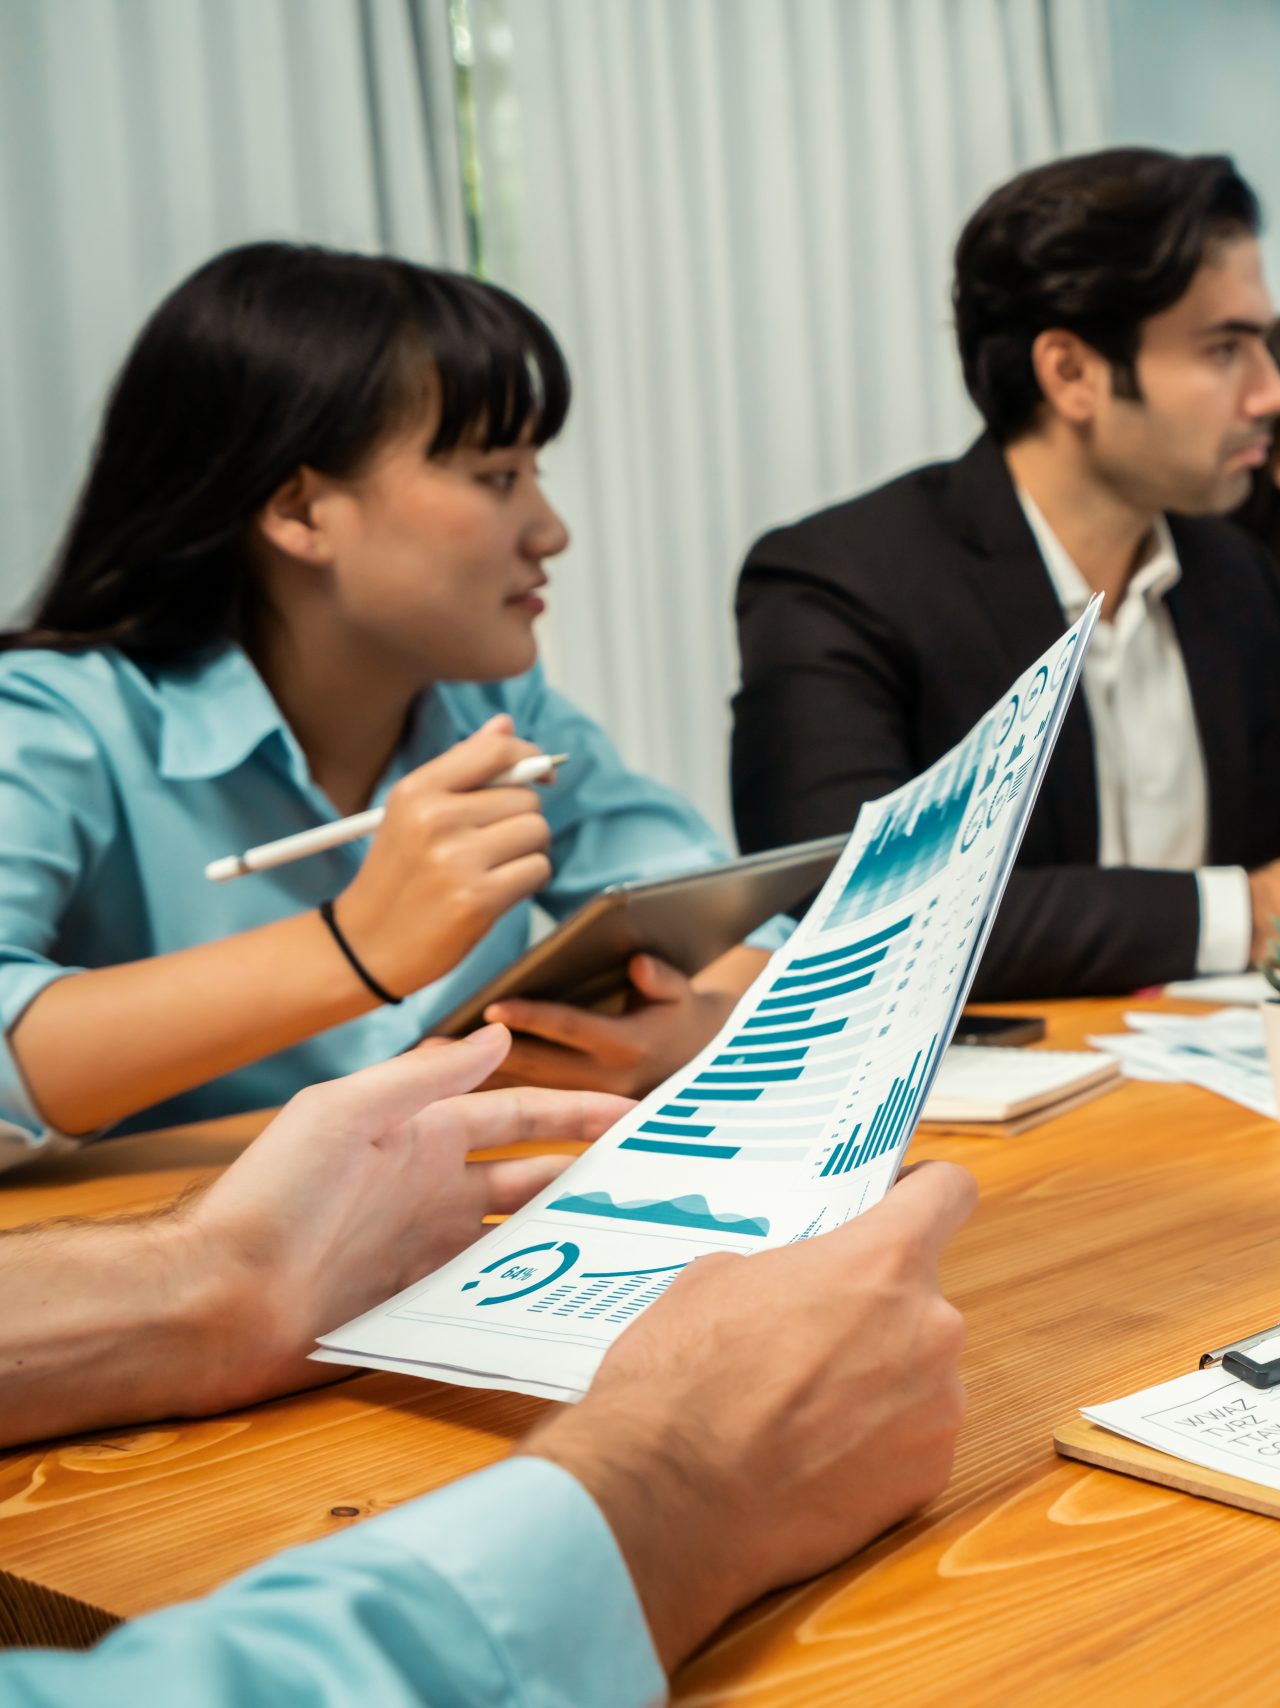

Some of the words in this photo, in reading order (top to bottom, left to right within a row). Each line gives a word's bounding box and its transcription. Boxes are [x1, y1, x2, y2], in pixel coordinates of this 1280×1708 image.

[500, 1266, 538, 1281] 64%
[1175, 1398, 1257, 1428] WWAZ
[1200, 1414, 1268, 1437] TVRZ
